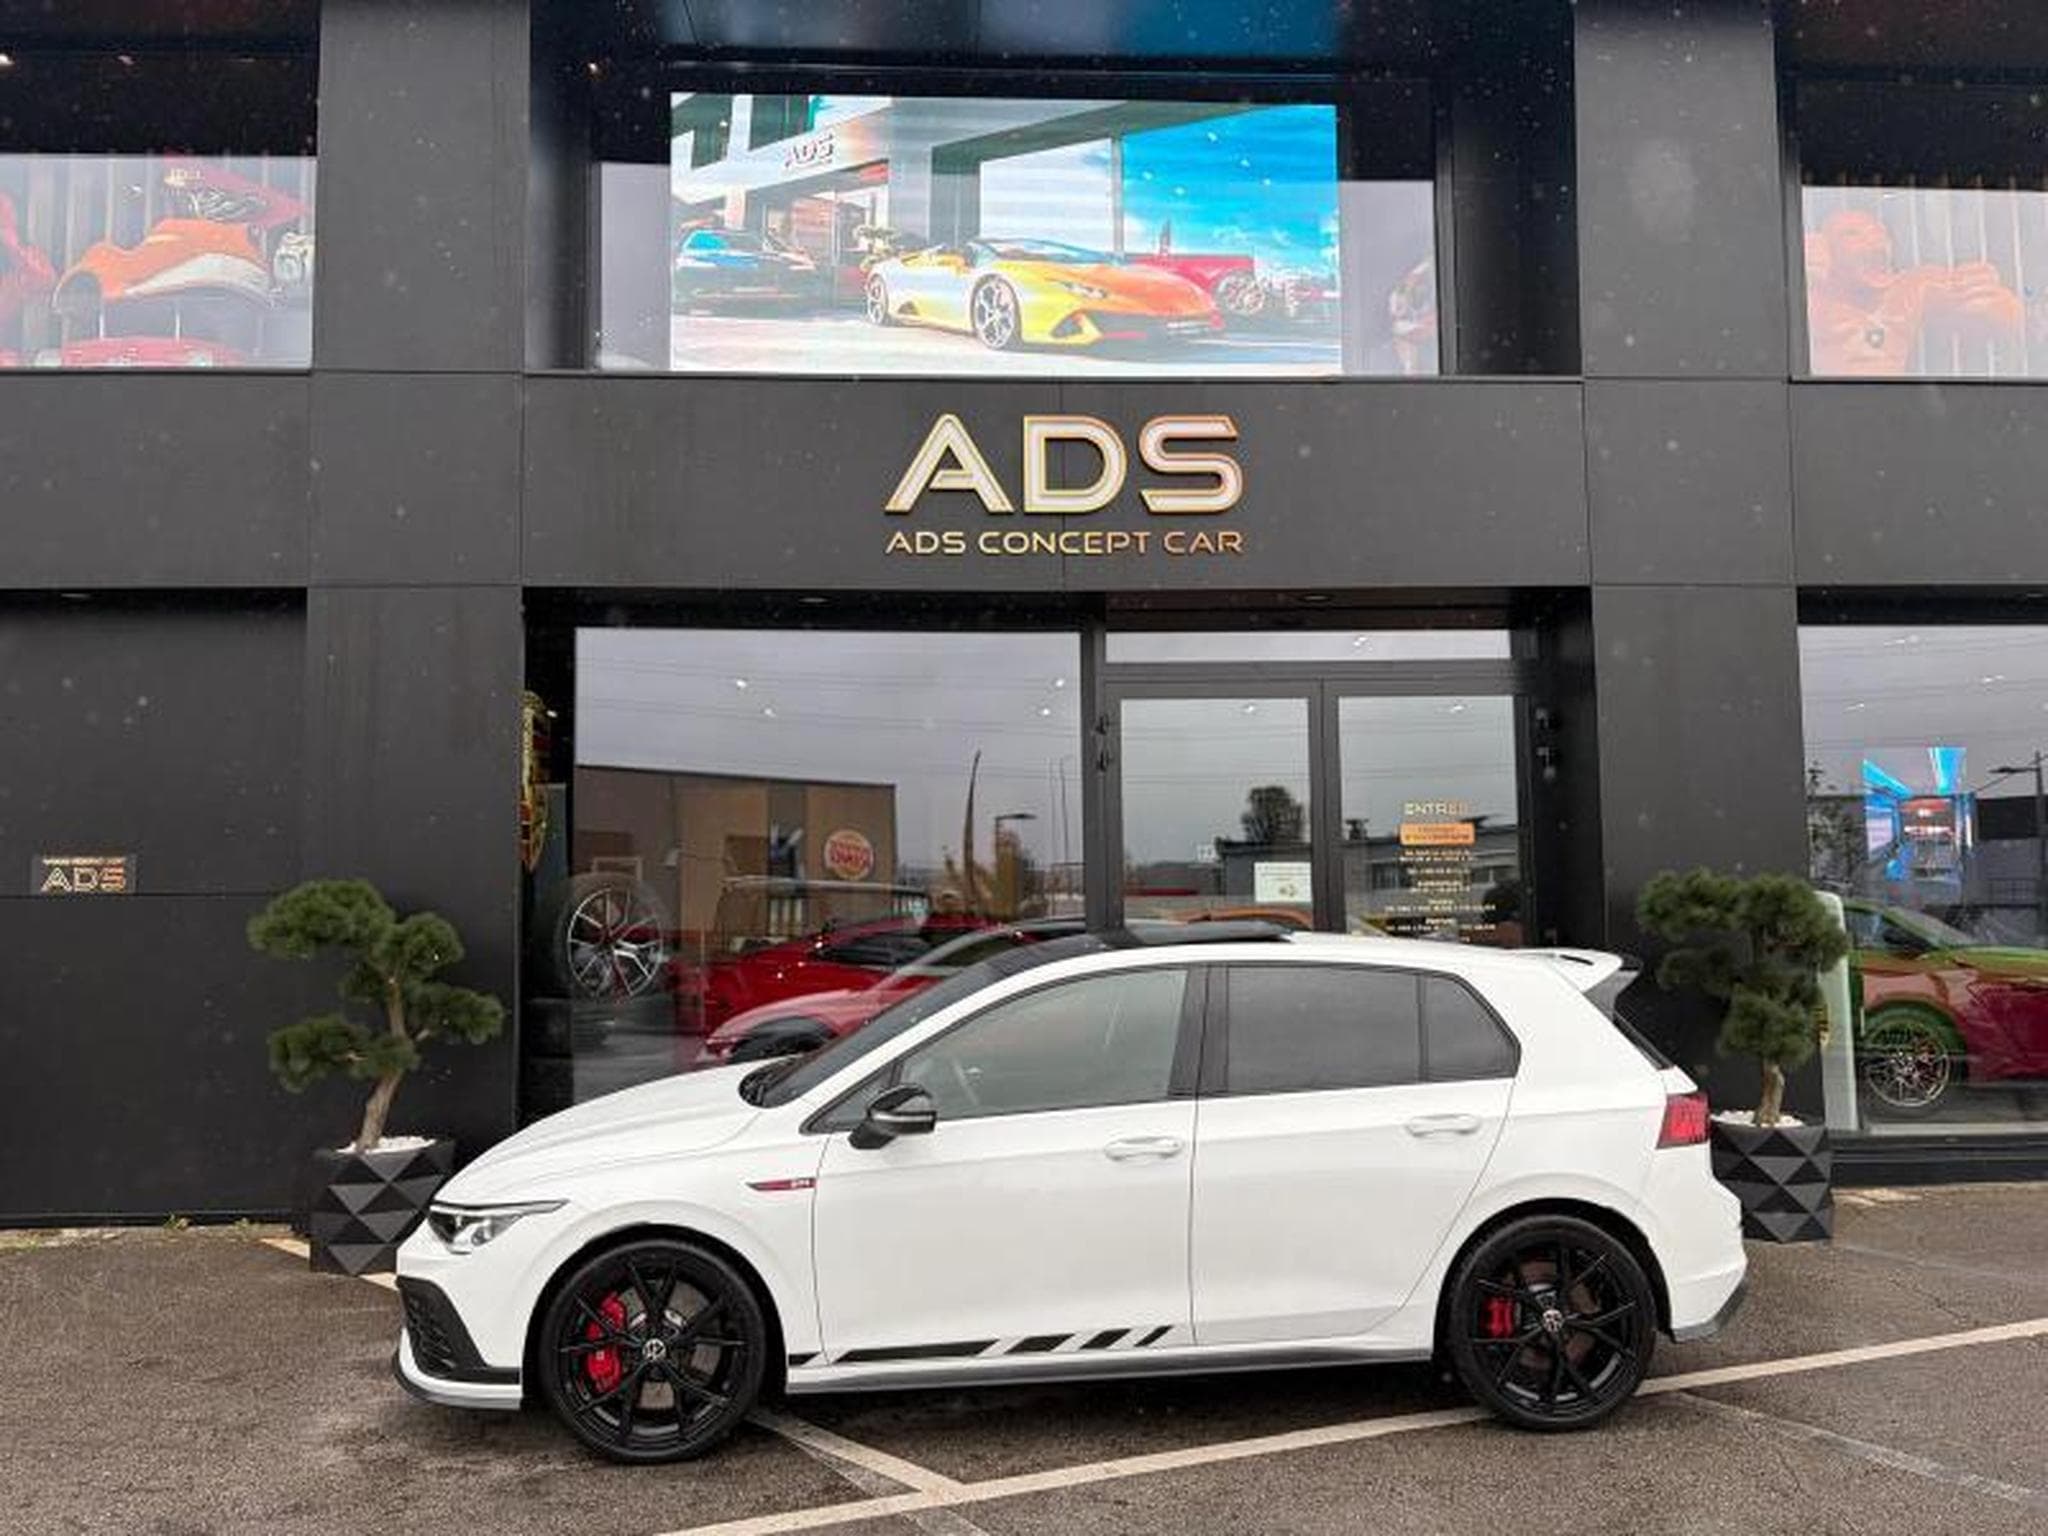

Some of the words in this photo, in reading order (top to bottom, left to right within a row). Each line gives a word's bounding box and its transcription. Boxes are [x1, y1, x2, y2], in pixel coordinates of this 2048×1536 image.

[885, 413, 1243, 513] ADS
[885, 531, 966, 554] ADS
[978, 531, 1151, 554] CONCEPT
[1163, 531, 1243, 554] CAR
[41, 867, 126, 892] ADS
